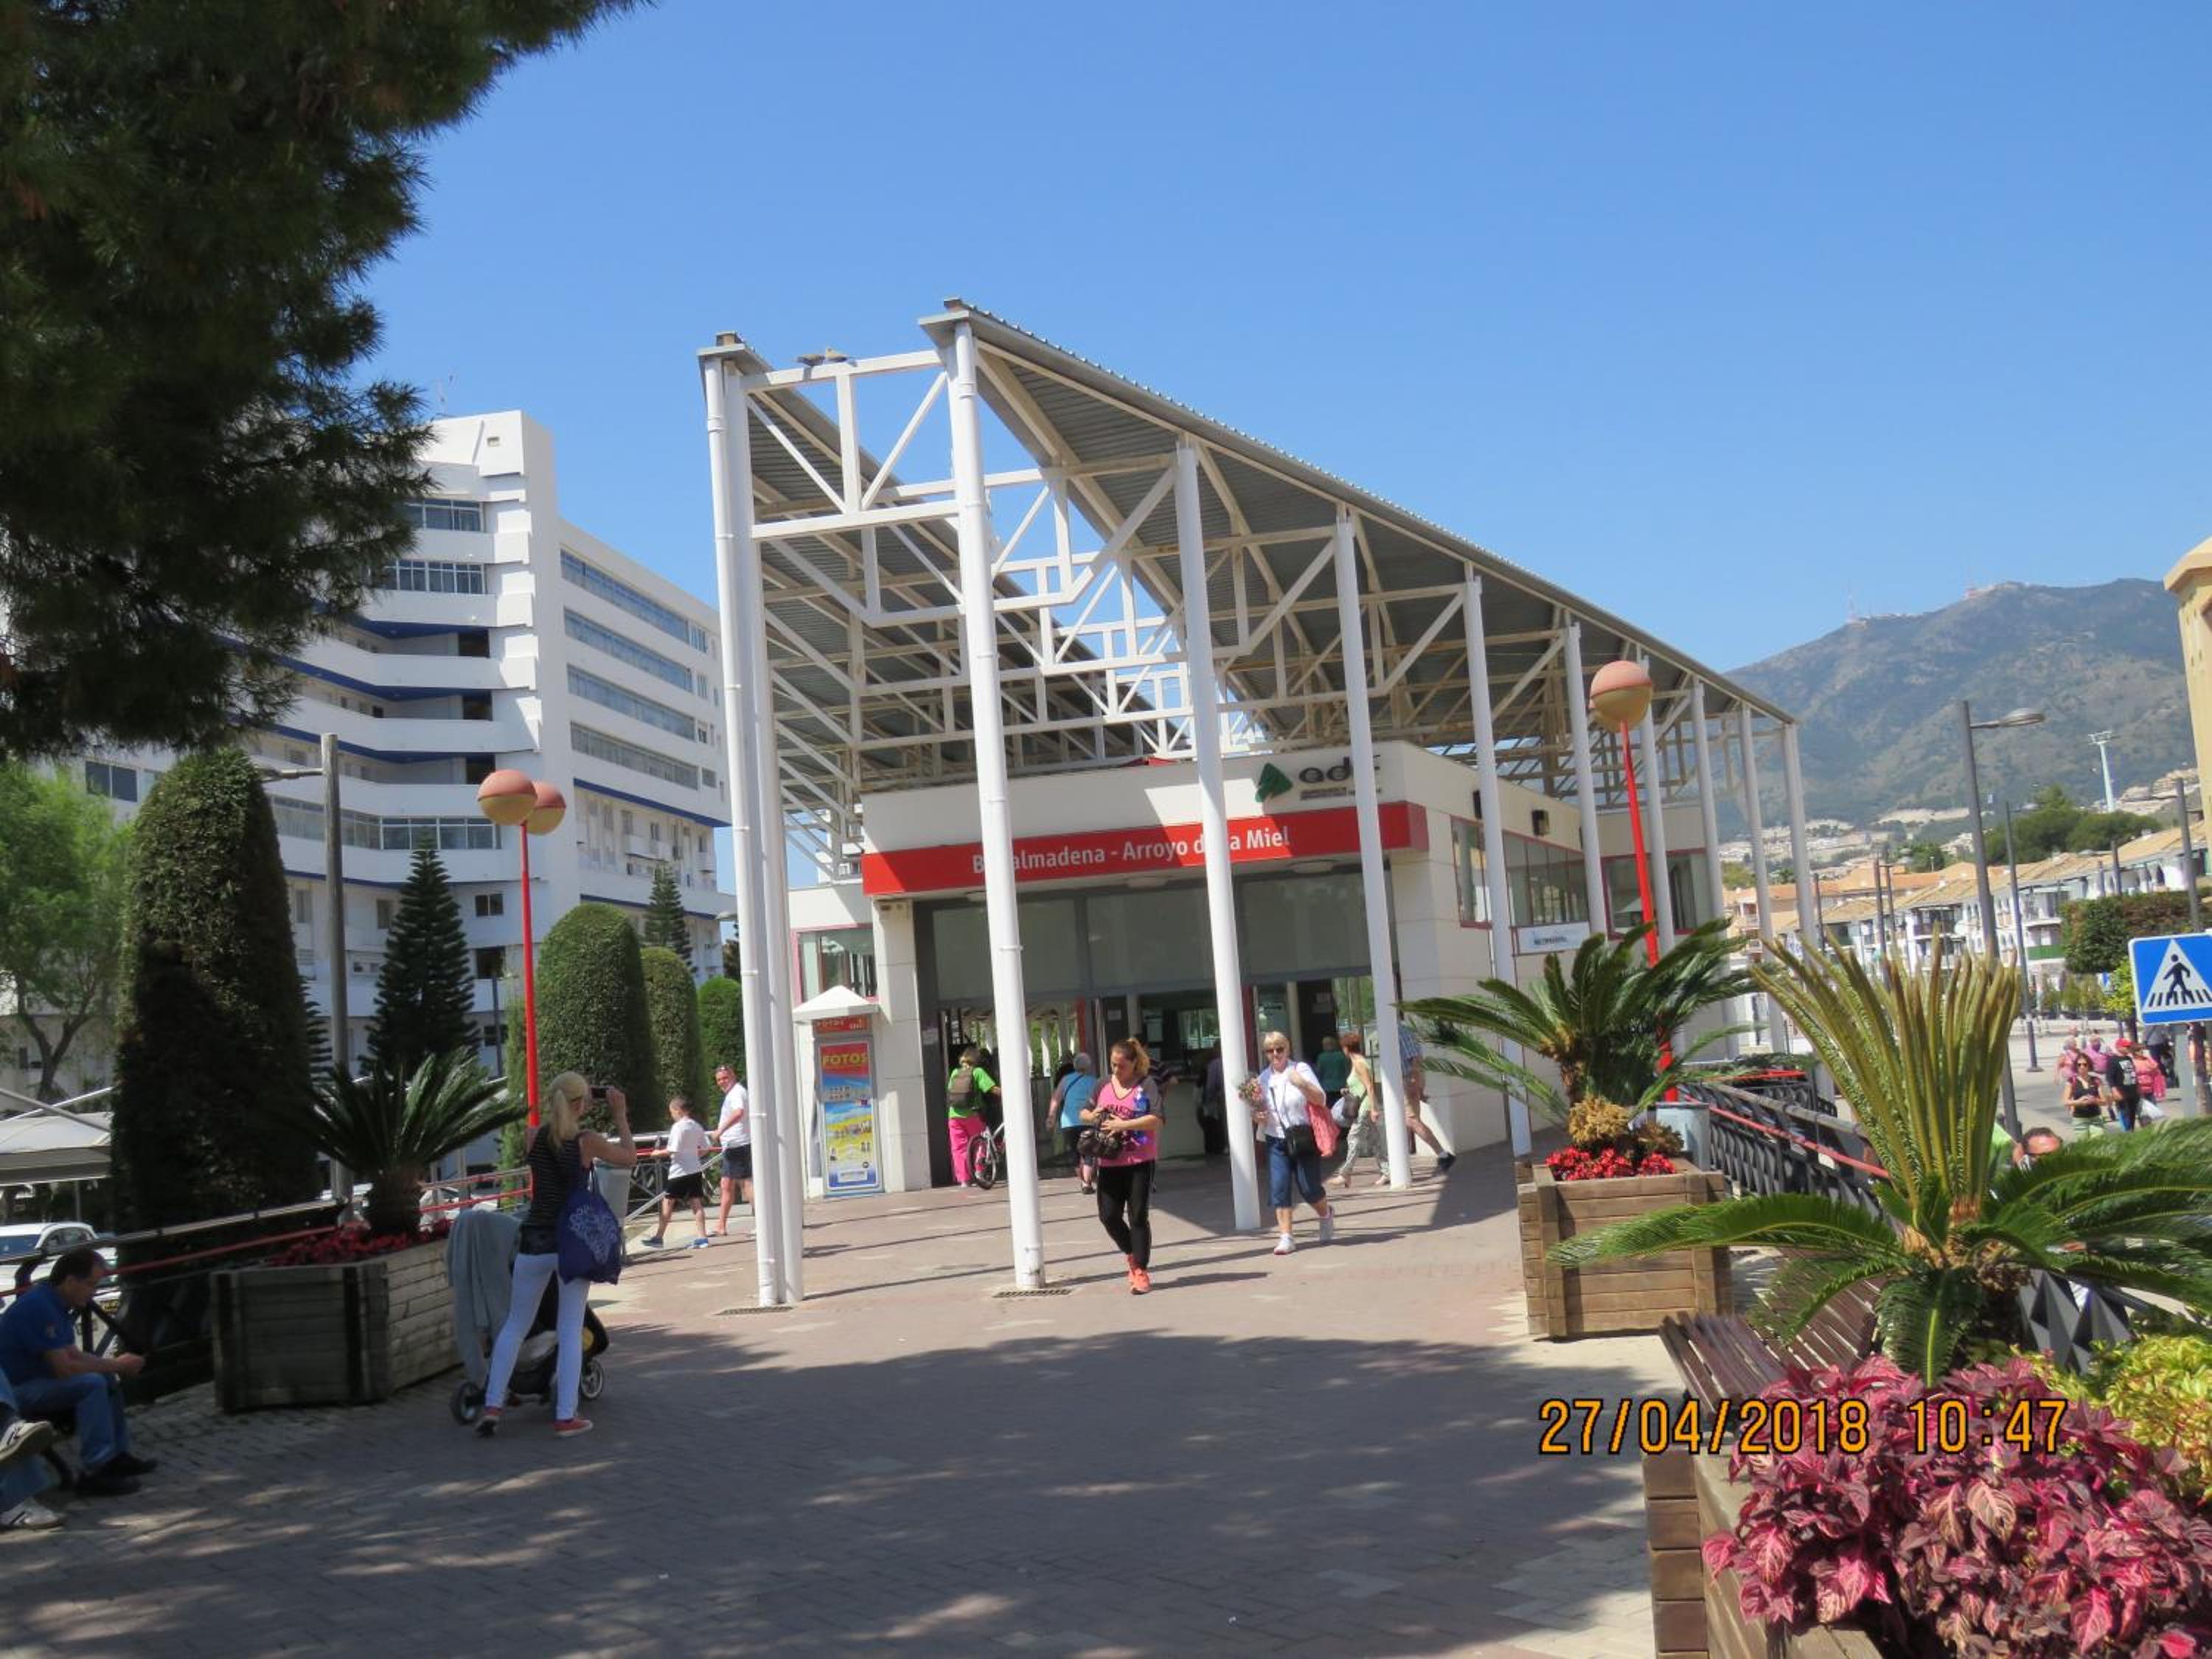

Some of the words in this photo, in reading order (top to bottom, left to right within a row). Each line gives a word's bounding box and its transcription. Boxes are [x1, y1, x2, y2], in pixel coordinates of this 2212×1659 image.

[1298, 754, 1381, 784] ad
[973, 846, 1105, 874] Balmadena
[1123, 839, 1186, 862] Arroyo
[1246, 826, 1290, 849] Miel
[822, 1052, 867, 1067] FOTOS
